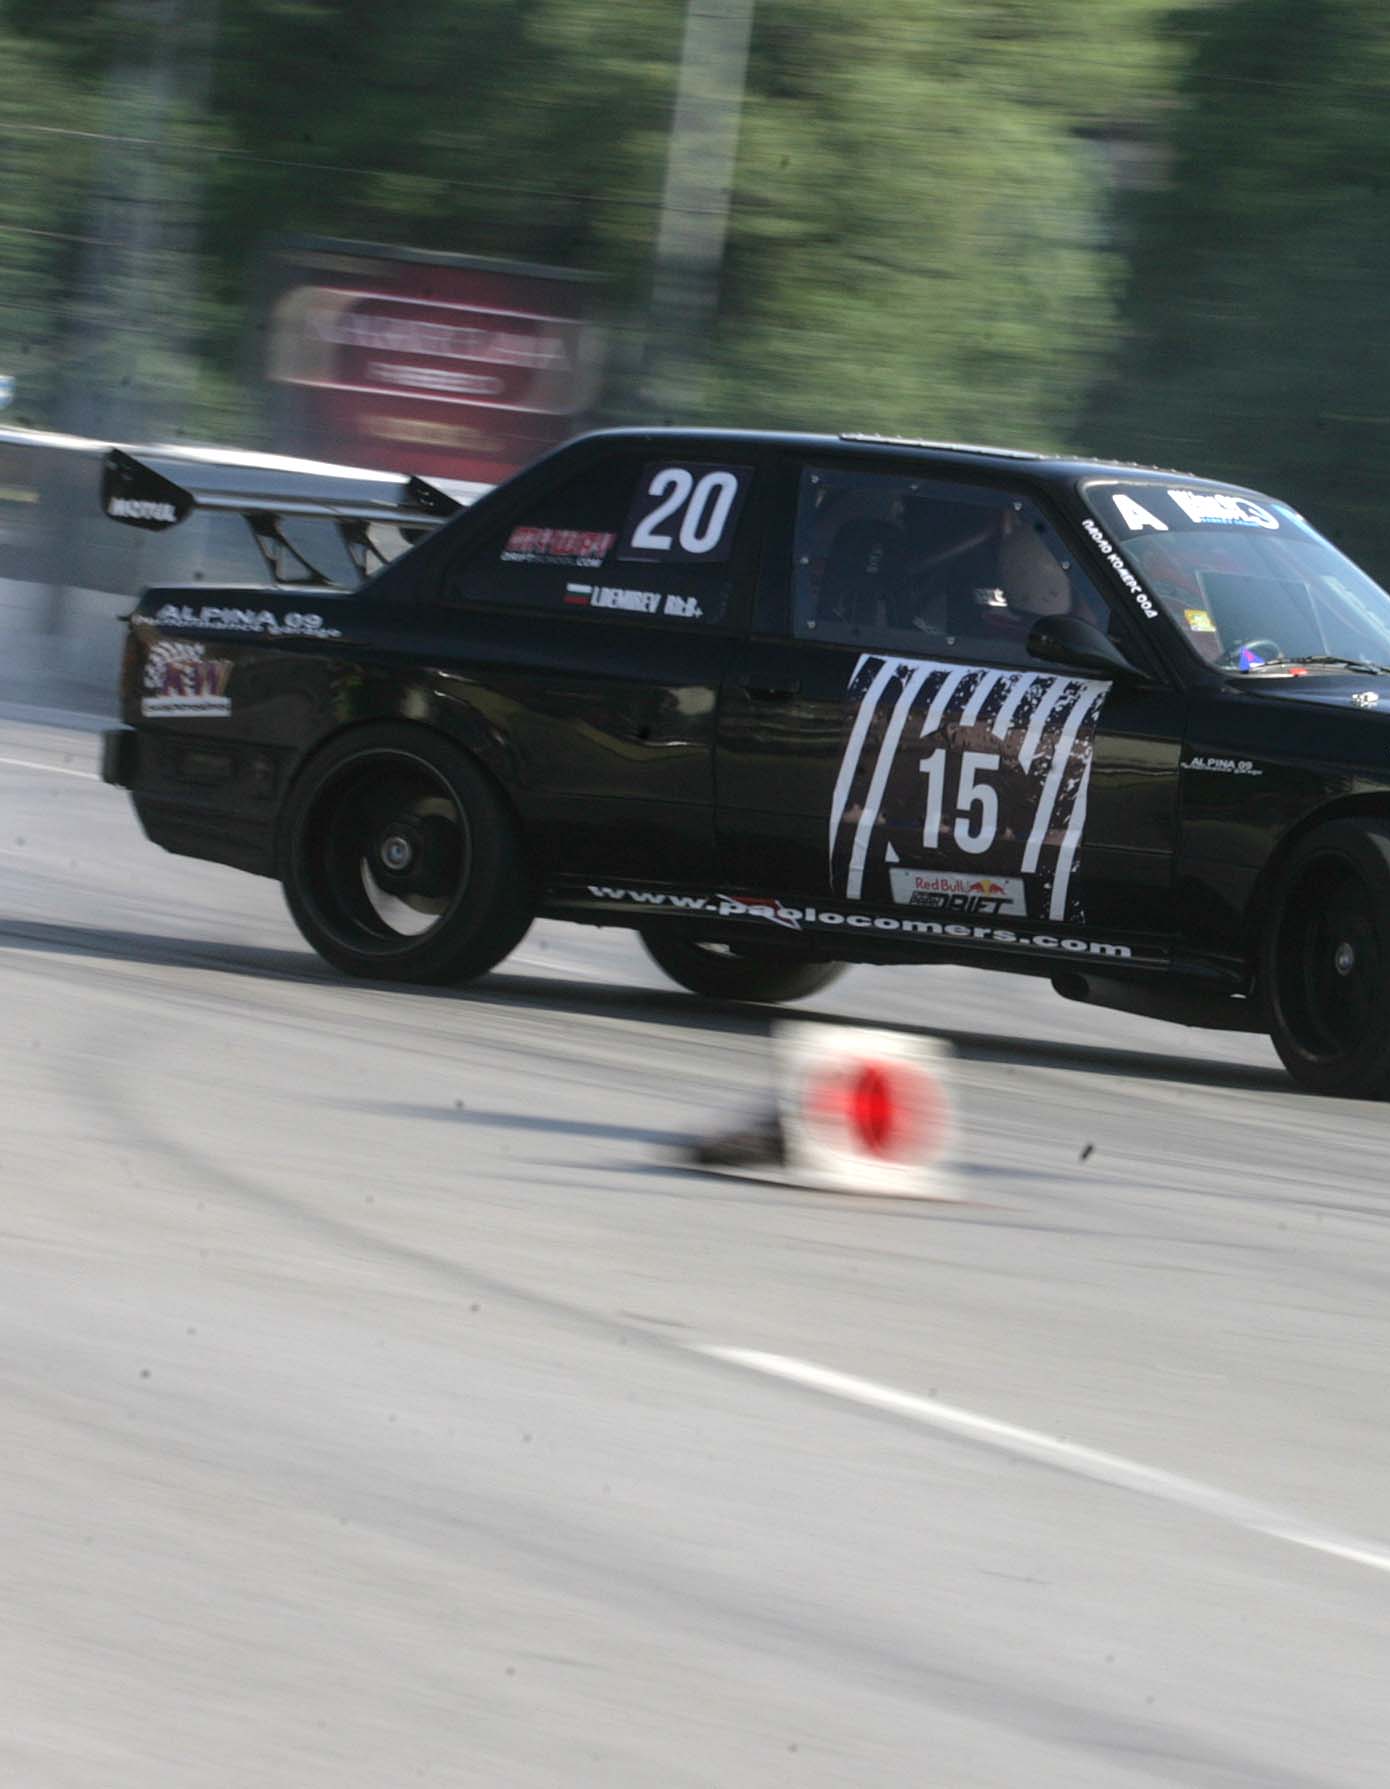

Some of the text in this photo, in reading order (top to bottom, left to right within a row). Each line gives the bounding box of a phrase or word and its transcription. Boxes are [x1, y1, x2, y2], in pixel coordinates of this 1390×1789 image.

[631, 467, 738, 553] 20
[1112, 494, 1169, 530] A
[156, 604, 278, 628] ALPINA
[1191, 757, 1235, 769] ALPINA
[919, 748, 999, 854] 15
[915, 876, 964, 892] Red Bull
